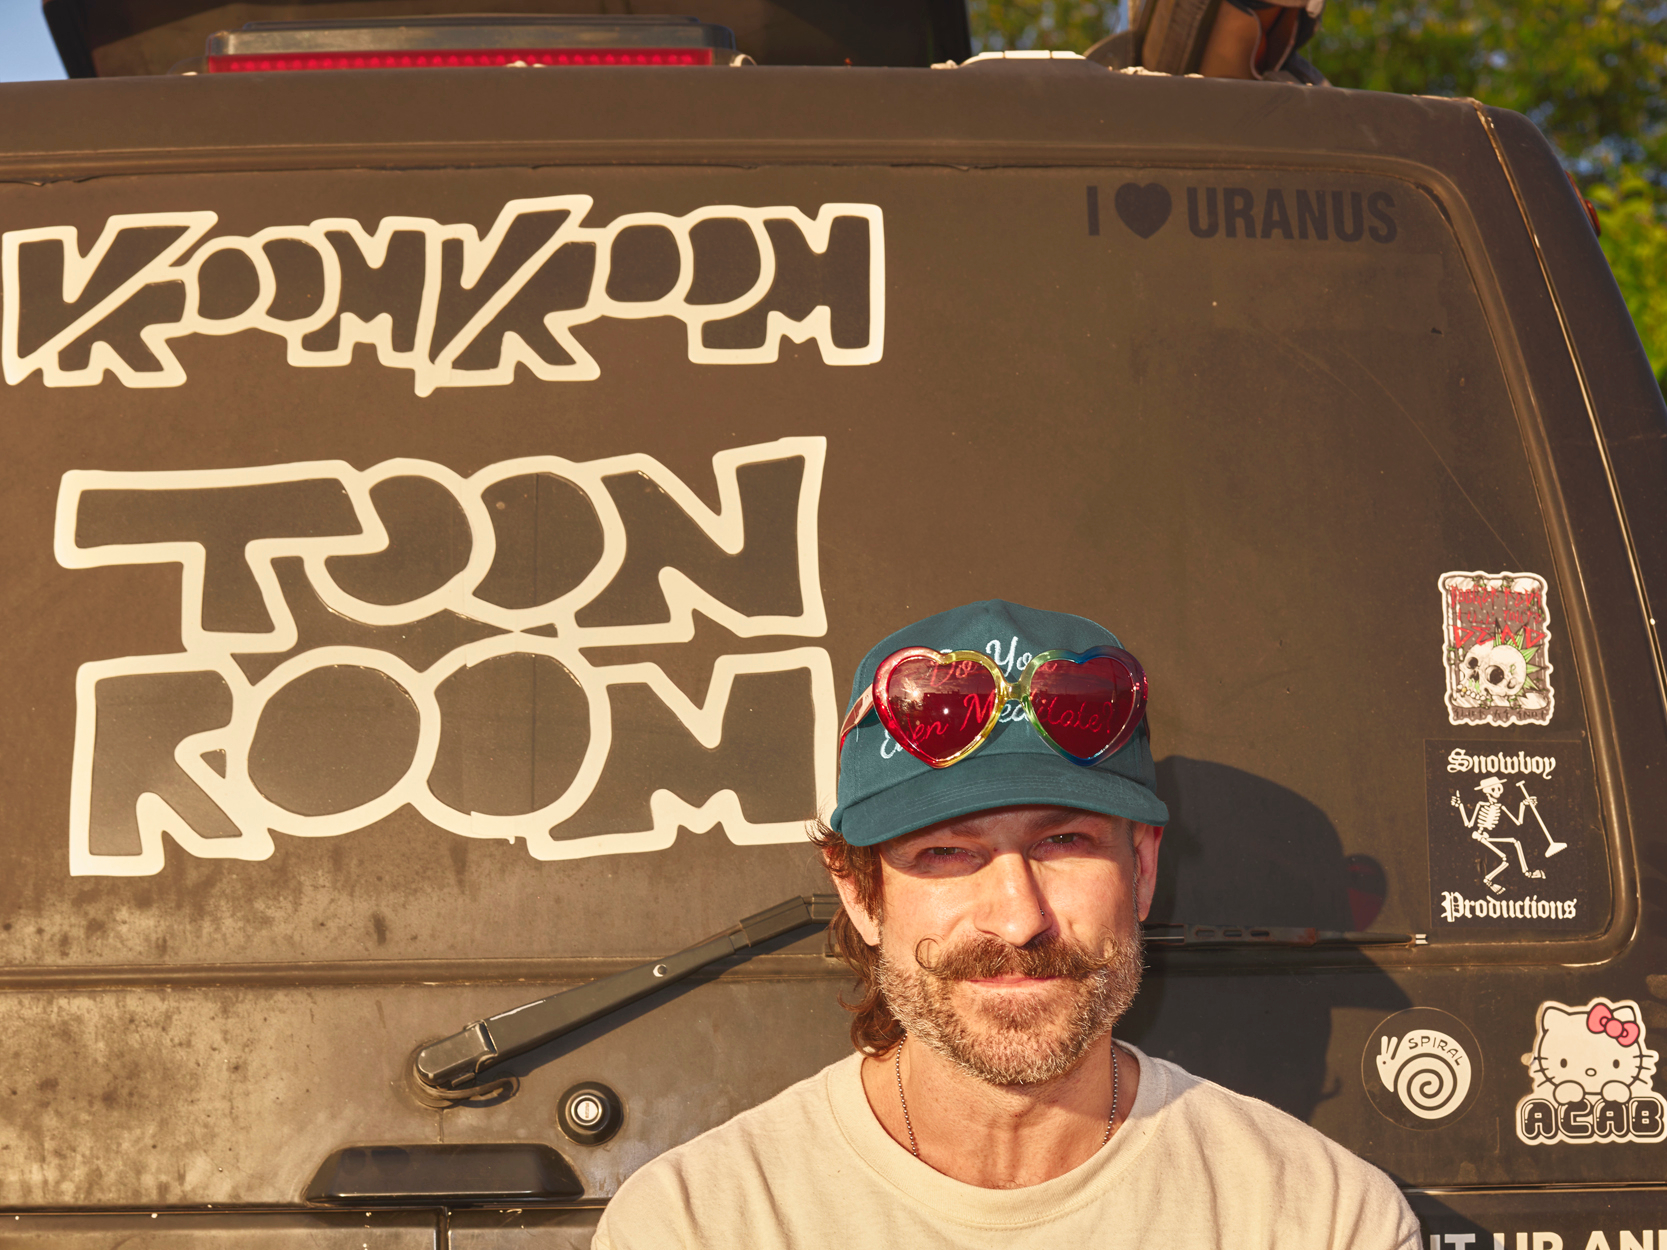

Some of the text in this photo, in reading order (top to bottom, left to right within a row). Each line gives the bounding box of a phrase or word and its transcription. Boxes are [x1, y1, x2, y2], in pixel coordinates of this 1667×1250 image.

[1086, 185, 1399, 244] I URANUS
[54, 436, 828, 655] TOON
[1452, 624, 1547, 649] DEAD
[880, 718, 950, 759] Een
[69, 645, 839, 877] ROOM
[1447, 748, 1557, 780] Snowboy
[1441, 891, 1578, 922] Productions
[1408, 1035, 1463, 1067] SPIRAL
[1521, 1097, 1665, 1139] ACAB
